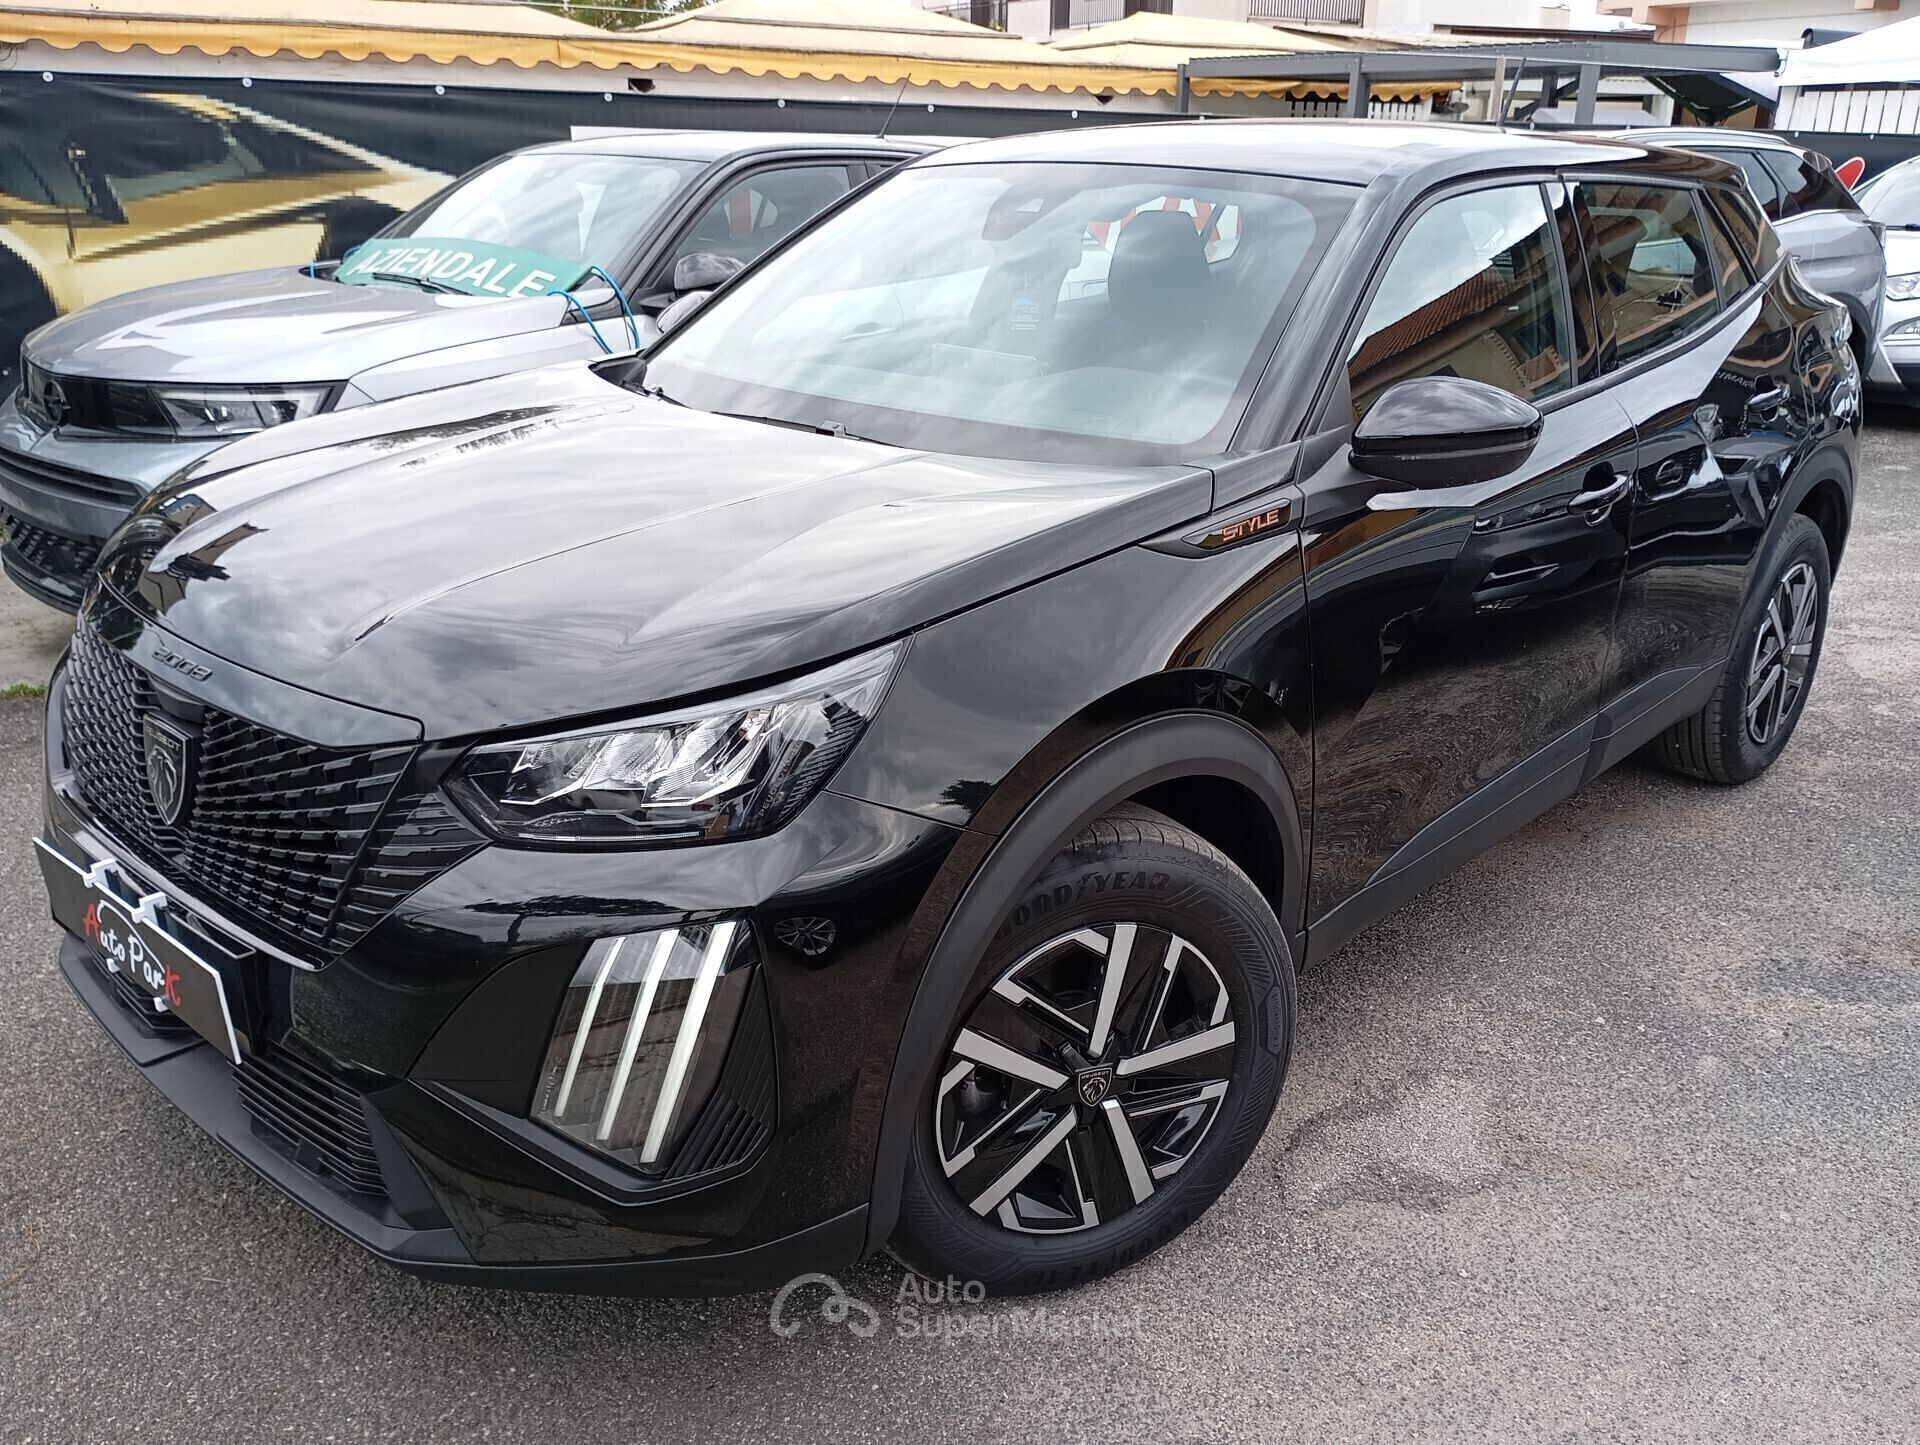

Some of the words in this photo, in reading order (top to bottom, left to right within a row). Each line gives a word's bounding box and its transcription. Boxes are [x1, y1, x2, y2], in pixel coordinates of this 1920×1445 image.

[346, 248, 557, 298] AZIENDALE
[1222, 509, 1280, 543] STYLE
[152, 647, 213, 681] 2008
